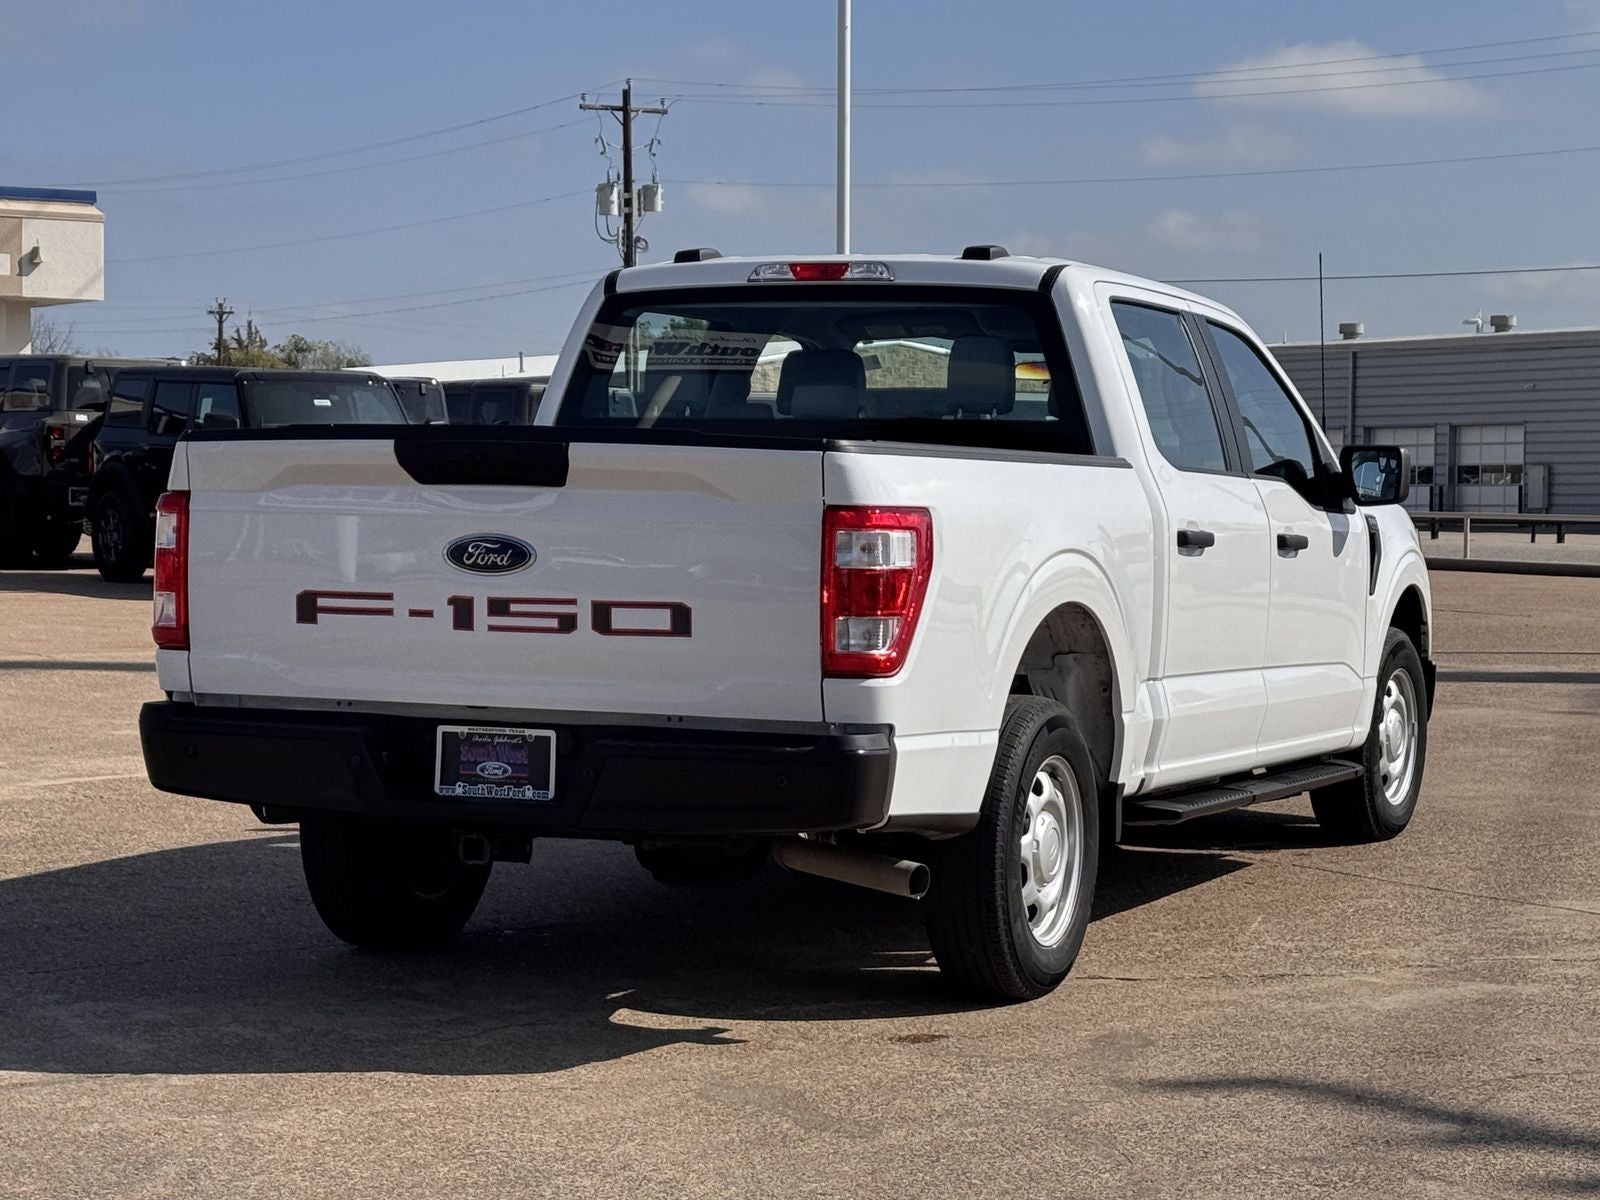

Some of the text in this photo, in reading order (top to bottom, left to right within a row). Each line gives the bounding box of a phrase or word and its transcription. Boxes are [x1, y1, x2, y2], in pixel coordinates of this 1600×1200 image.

[463, 541, 512, 567] Ford
[296, 588, 692, 638] F-150
[485, 763, 505, 776] Ford
[438, 783, 550, 800] www.SouthWestFord.com
